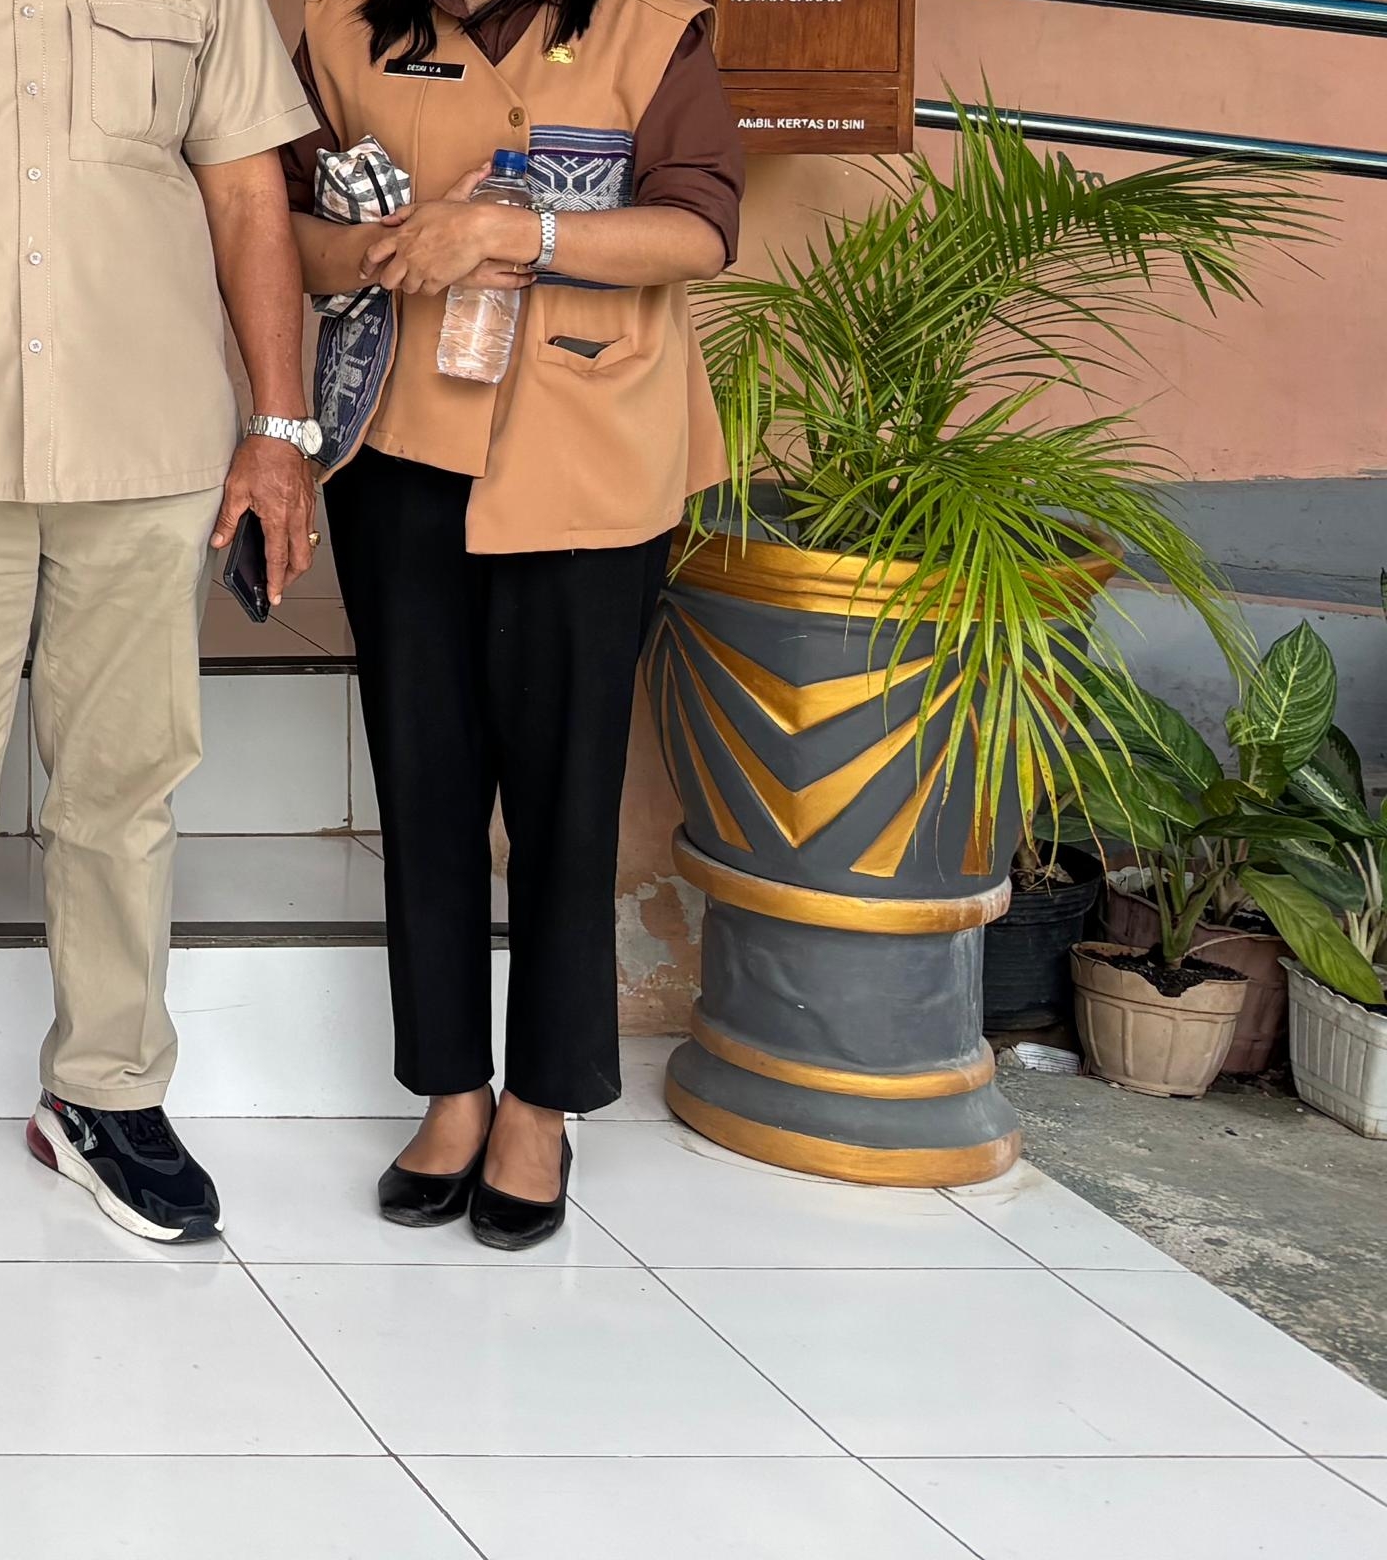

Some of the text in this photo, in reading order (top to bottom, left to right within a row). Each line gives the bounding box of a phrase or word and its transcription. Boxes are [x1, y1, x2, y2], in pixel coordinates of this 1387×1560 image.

[738, 118, 865, 130] AMBIL KERTAS DI SINI
